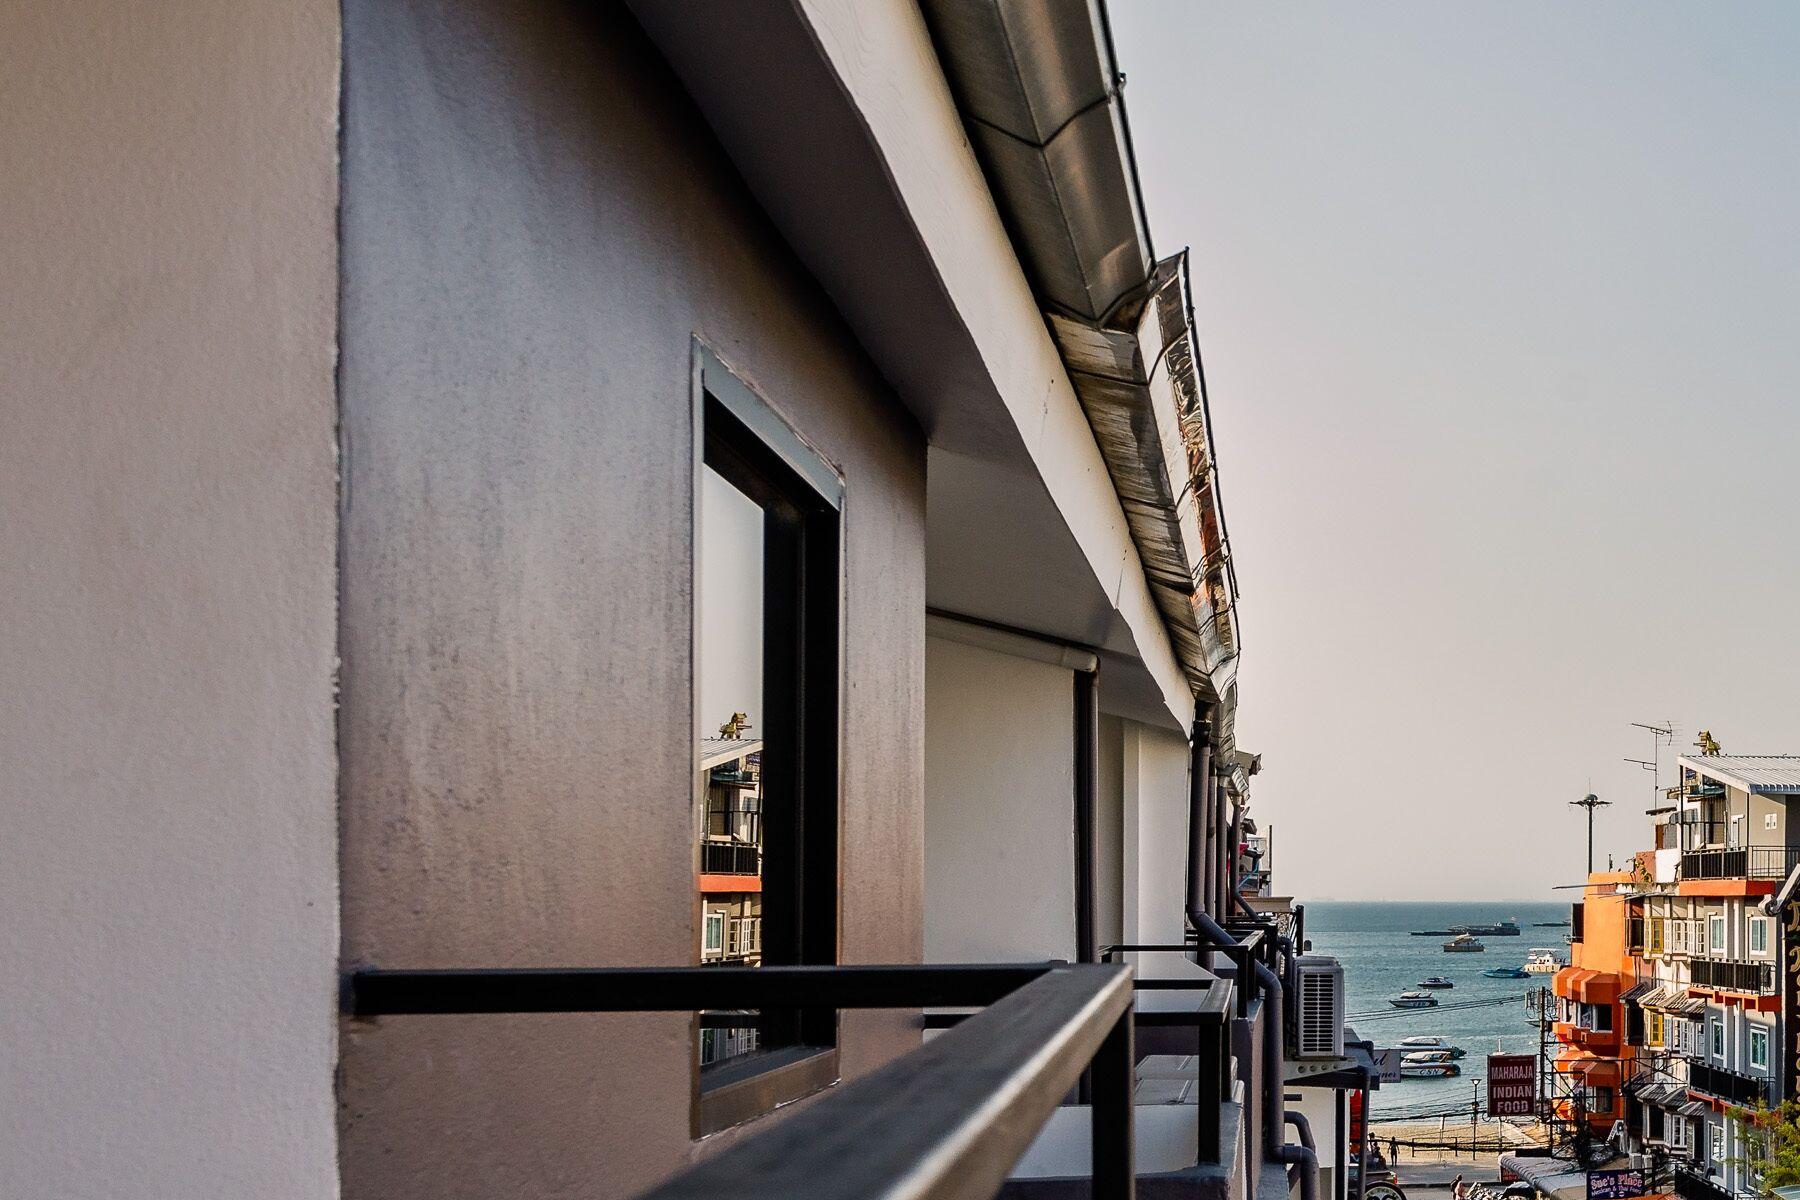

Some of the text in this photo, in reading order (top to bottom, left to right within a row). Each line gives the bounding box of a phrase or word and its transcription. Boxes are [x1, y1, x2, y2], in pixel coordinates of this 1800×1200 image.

[1491, 1065, 1534, 1080] MAHARAJA
[1493, 1085, 1533, 1099] INDIAN
[1497, 1100, 1529, 1113] FOOD
[1617, 1172, 1643, 1188] Place
